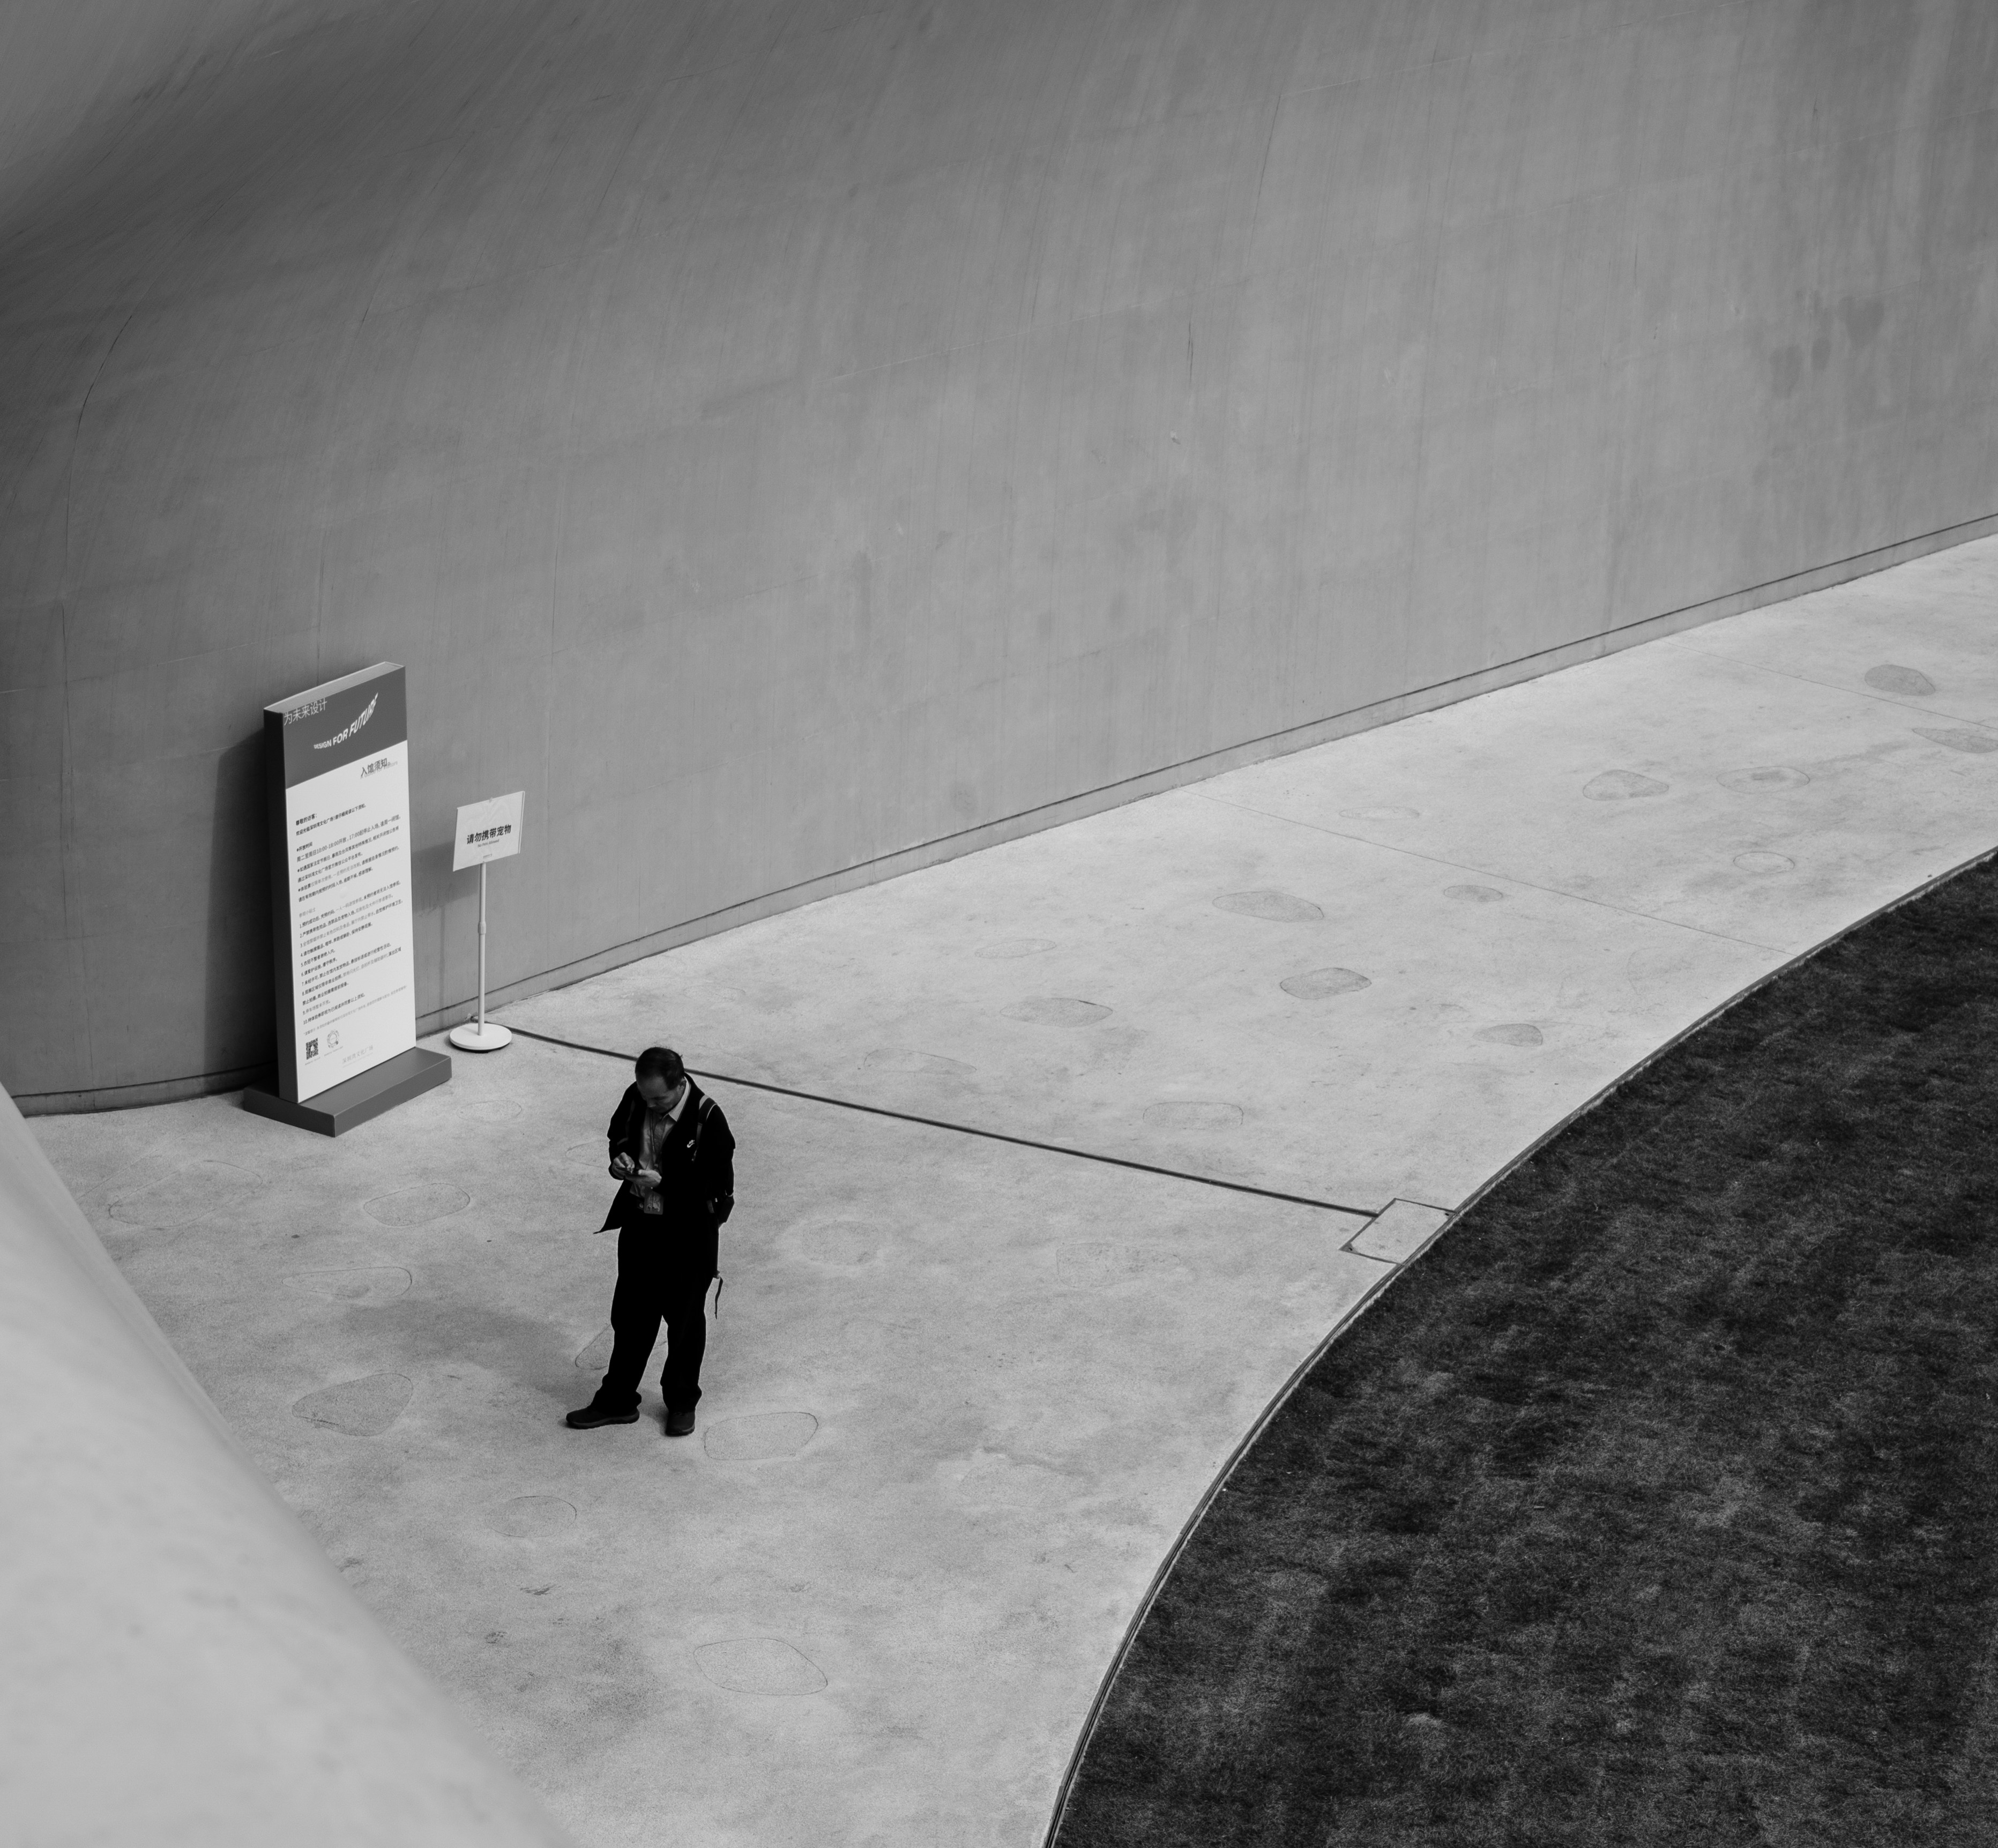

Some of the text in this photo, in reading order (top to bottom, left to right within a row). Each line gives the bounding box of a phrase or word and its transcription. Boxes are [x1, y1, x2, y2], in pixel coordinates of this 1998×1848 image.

[284, 698, 327, 726] 为未来设计
[313, 692, 378, 749] DESIGN FOR FUTURE
[467, 824, 511, 845] 请勿携带宠物
